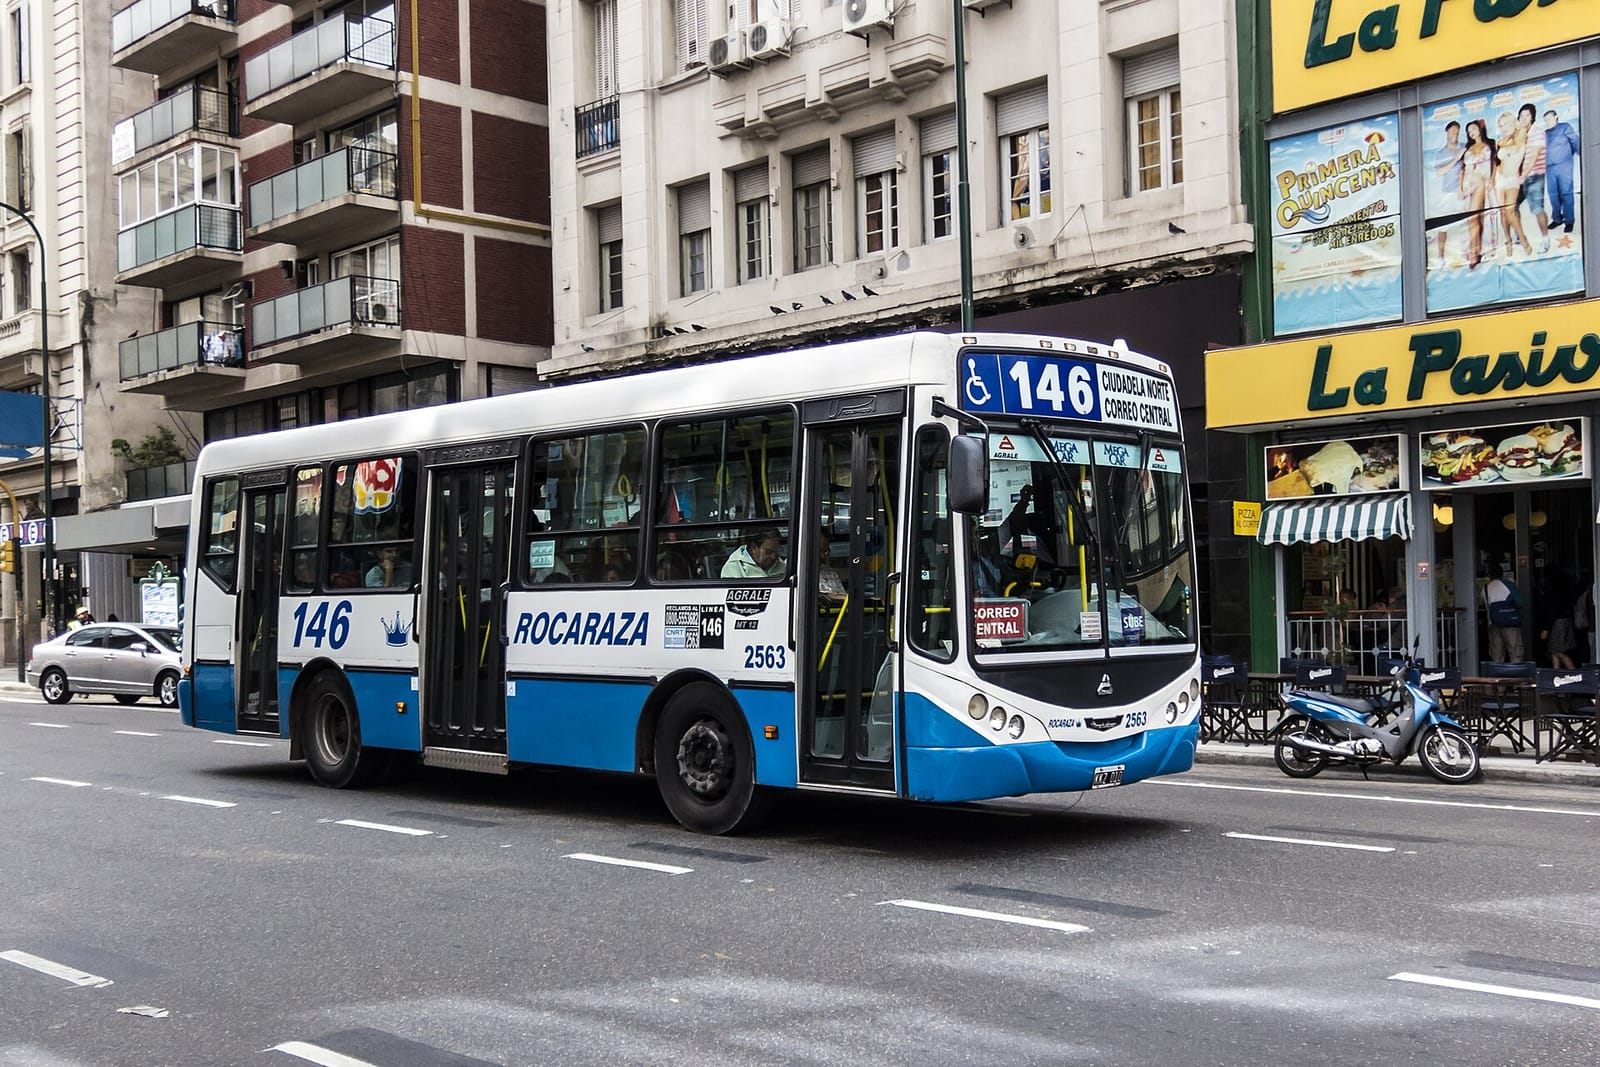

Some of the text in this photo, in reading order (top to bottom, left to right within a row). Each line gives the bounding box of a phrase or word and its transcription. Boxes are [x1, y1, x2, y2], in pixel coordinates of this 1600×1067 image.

[1303, 0, 1400, 69] La
[1276, 142, 1382, 200] PRIMERA
[1276, 161, 1396, 229] QUINCENA
[1328, 222, 1395, 250] MIL ENREDOS
[1102, 370, 1171, 402] CIUDADELA NORTE
[1307, 343, 1389, 411] La
[1009, 360, 1094, 415] 146
[1104, 397, 1173, 427] CORREO CENTRAL
[1051, 440, 1079, 454] MEGA
[1104, 443, 1130, 457] MEGA
[1108, 454, 1127, 466] CAR
[1238, 508, 1256, 519] PIZZA
[726, 590, 771, 601] AGRALE
[974, 606, 1020, 619] ORREO
[1123, 612, 1144, 629] SUBE
[291, 599, 353, 650] 146
[513, 610, 650, 647] ROCARAZA
[701, 617, 723, 637] 146
[735, 621, 748, 629] MT
[975, 621, 1020, 636] ENTRAL
[744, 644, 786, 669] 2563
[1048, 718, 1075, 729] ROCARAZA
[1125, 711, 1148, 729] 2563
